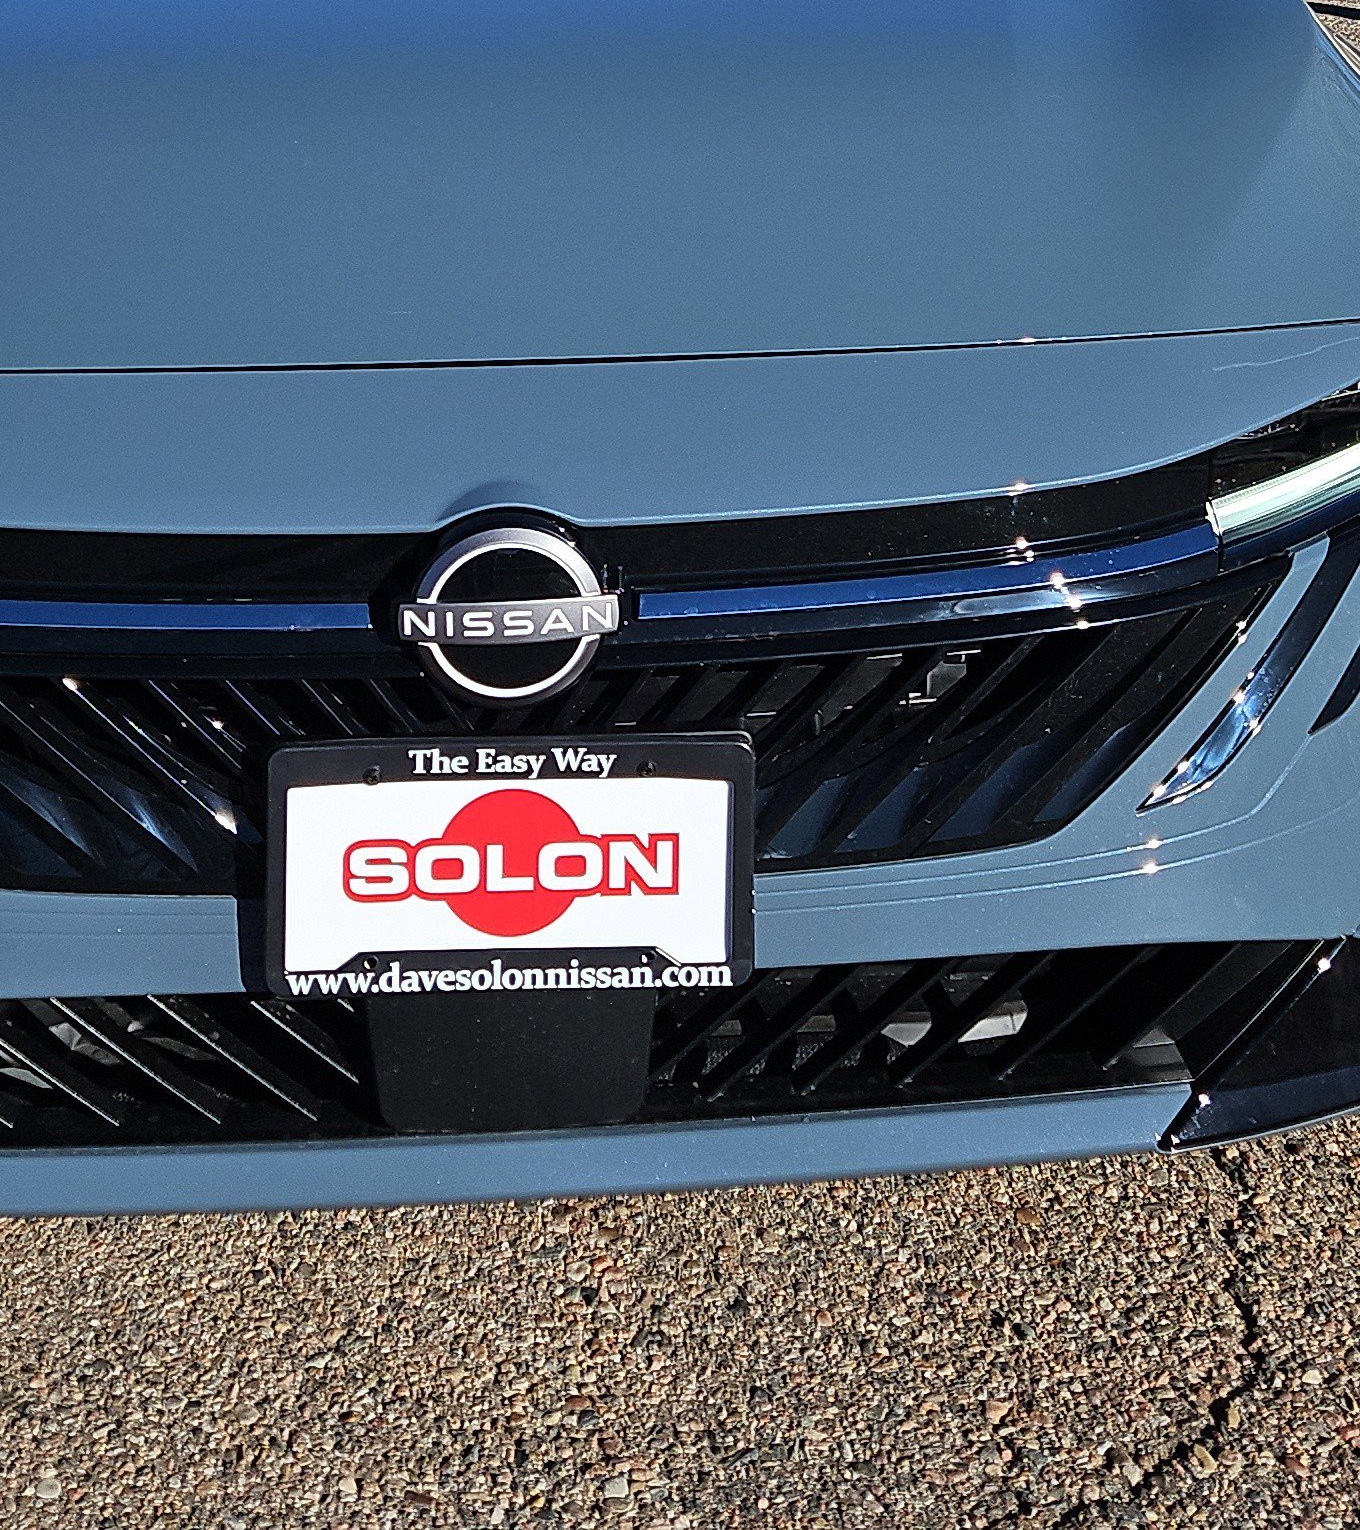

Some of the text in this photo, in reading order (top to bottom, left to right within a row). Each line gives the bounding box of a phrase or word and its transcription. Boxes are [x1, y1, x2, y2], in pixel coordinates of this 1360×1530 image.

[402, 601, 614, 638] NISSAN
[408, 747, 617, 779] The Easy Way
[345, 836, 677, 900] SOLON
[284, 958, 734, 996] www.davesolonnissan.com
